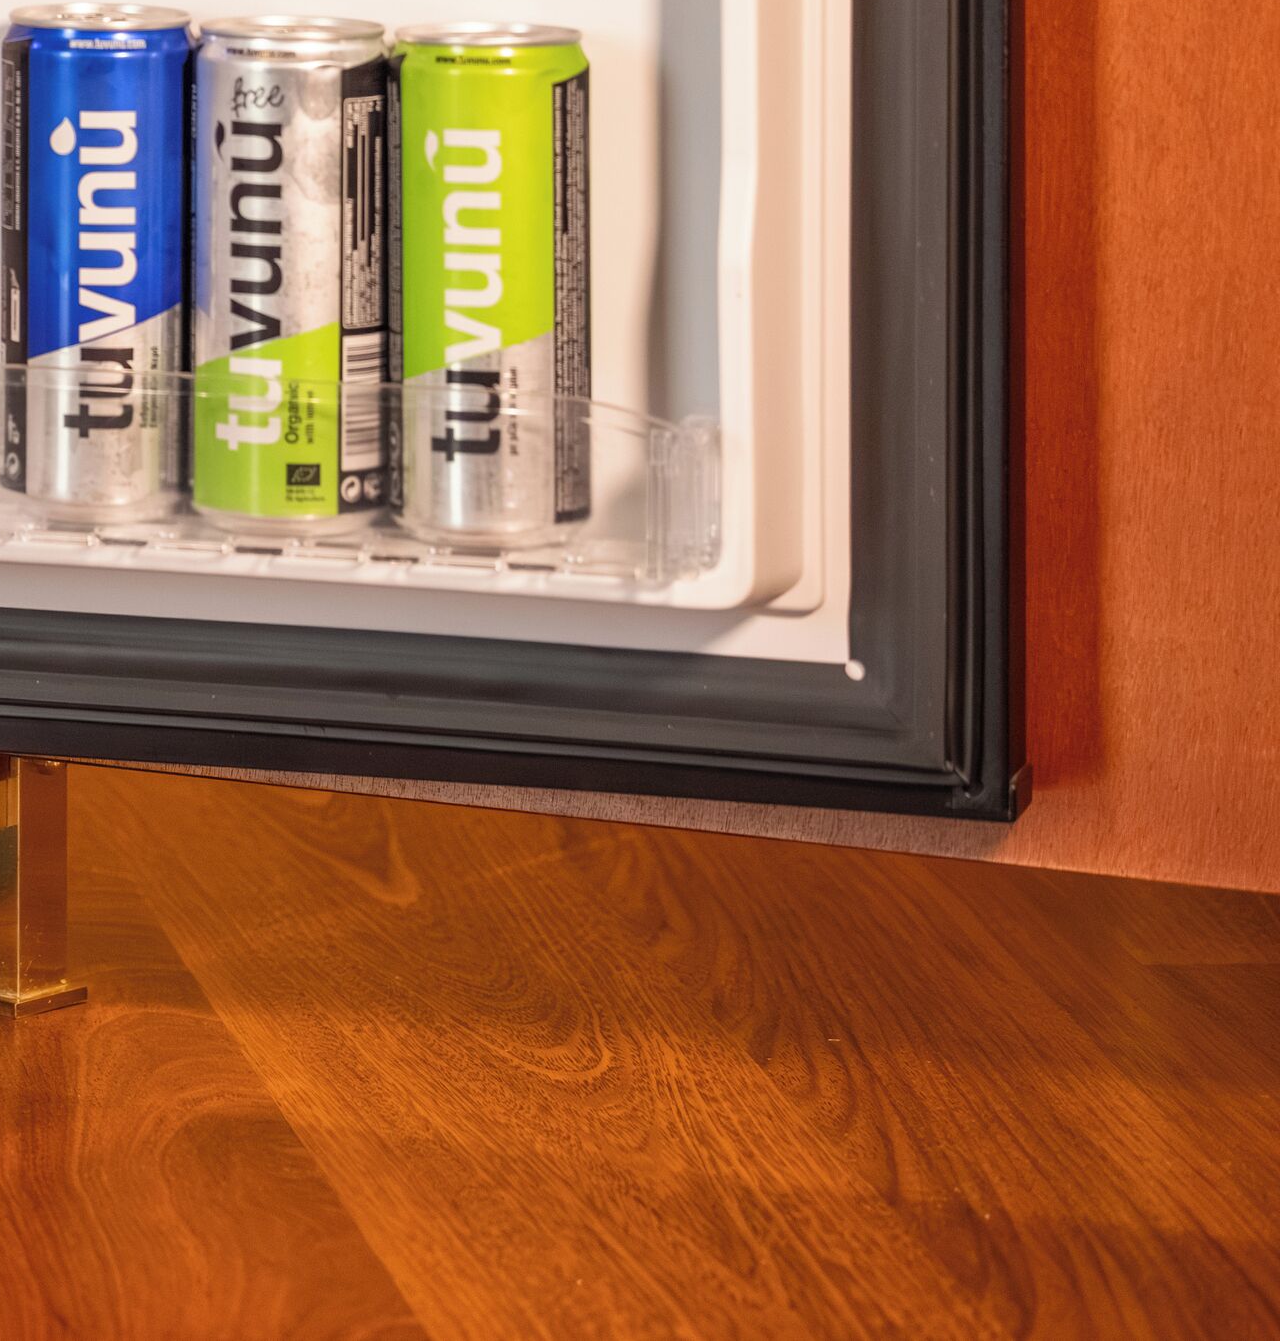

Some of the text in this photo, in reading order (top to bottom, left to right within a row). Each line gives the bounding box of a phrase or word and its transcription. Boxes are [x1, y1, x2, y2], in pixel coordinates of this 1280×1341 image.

[231, 78, 285, 113] free
[64, 110, 139, 439] tuvunu
[215, 120, 285, 451] tuvunu
[284, 382, 302, 445] Organic
[431, 128, 504, 462] tuvunu
